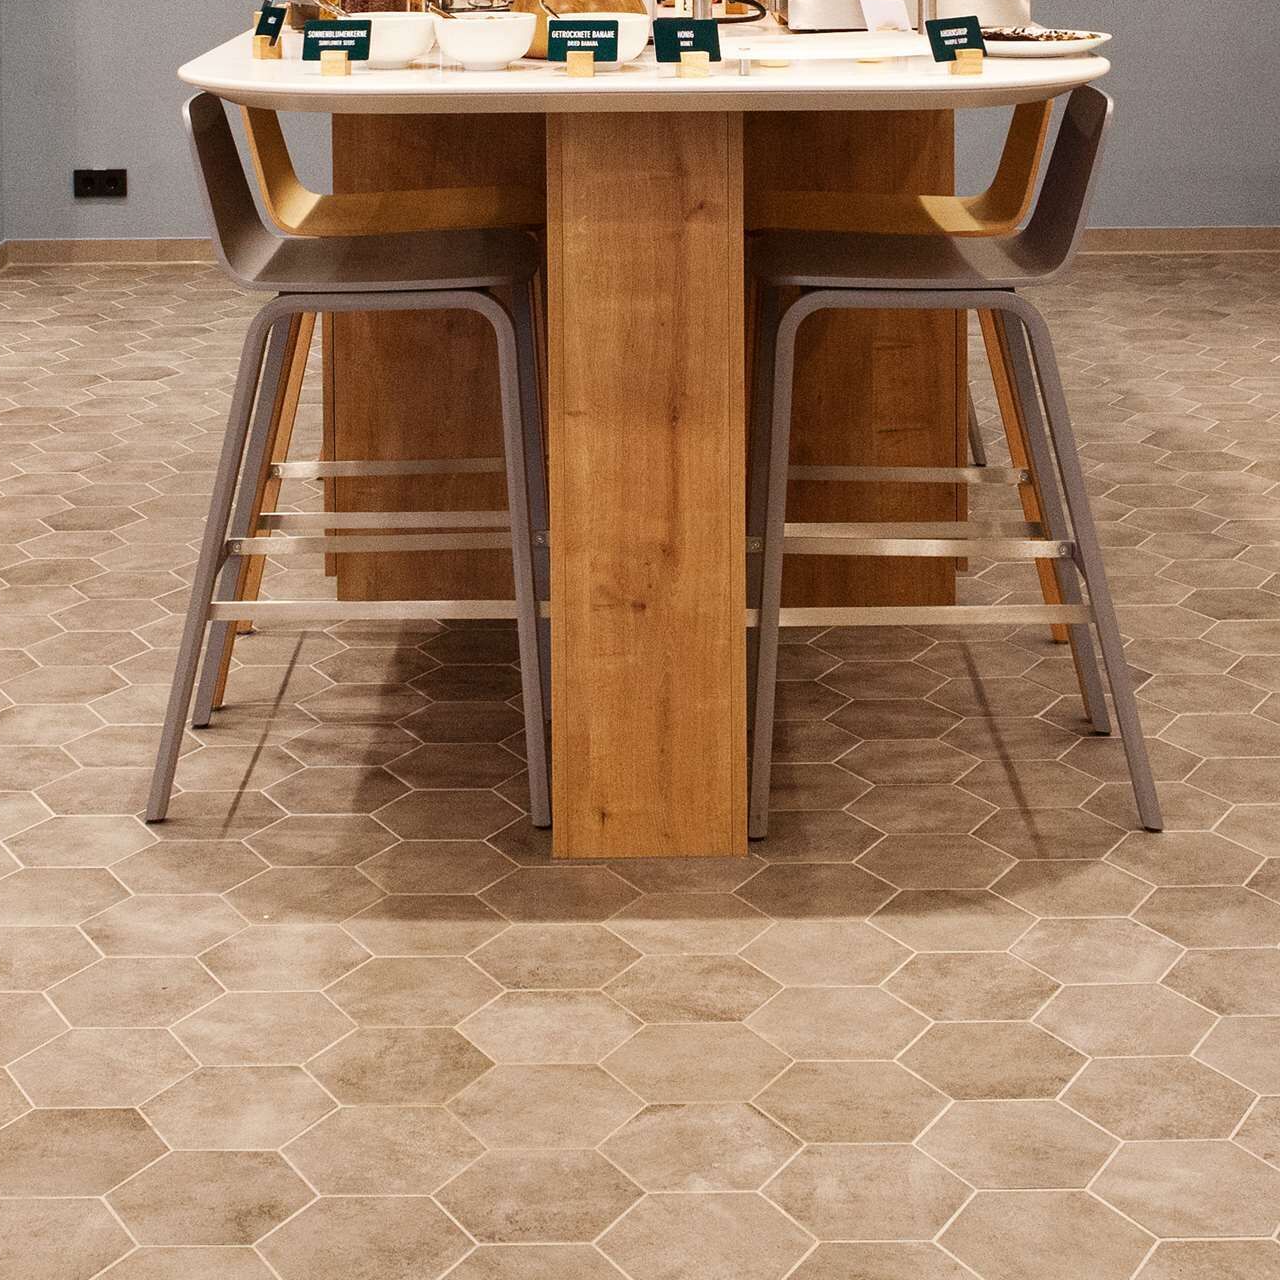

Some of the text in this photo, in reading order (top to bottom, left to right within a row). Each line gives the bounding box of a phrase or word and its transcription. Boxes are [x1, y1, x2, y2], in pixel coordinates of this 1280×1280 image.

[551, 30, 615, 39] GETROCKNETE BANANE
[677, 30, 695, 39] HONIG
